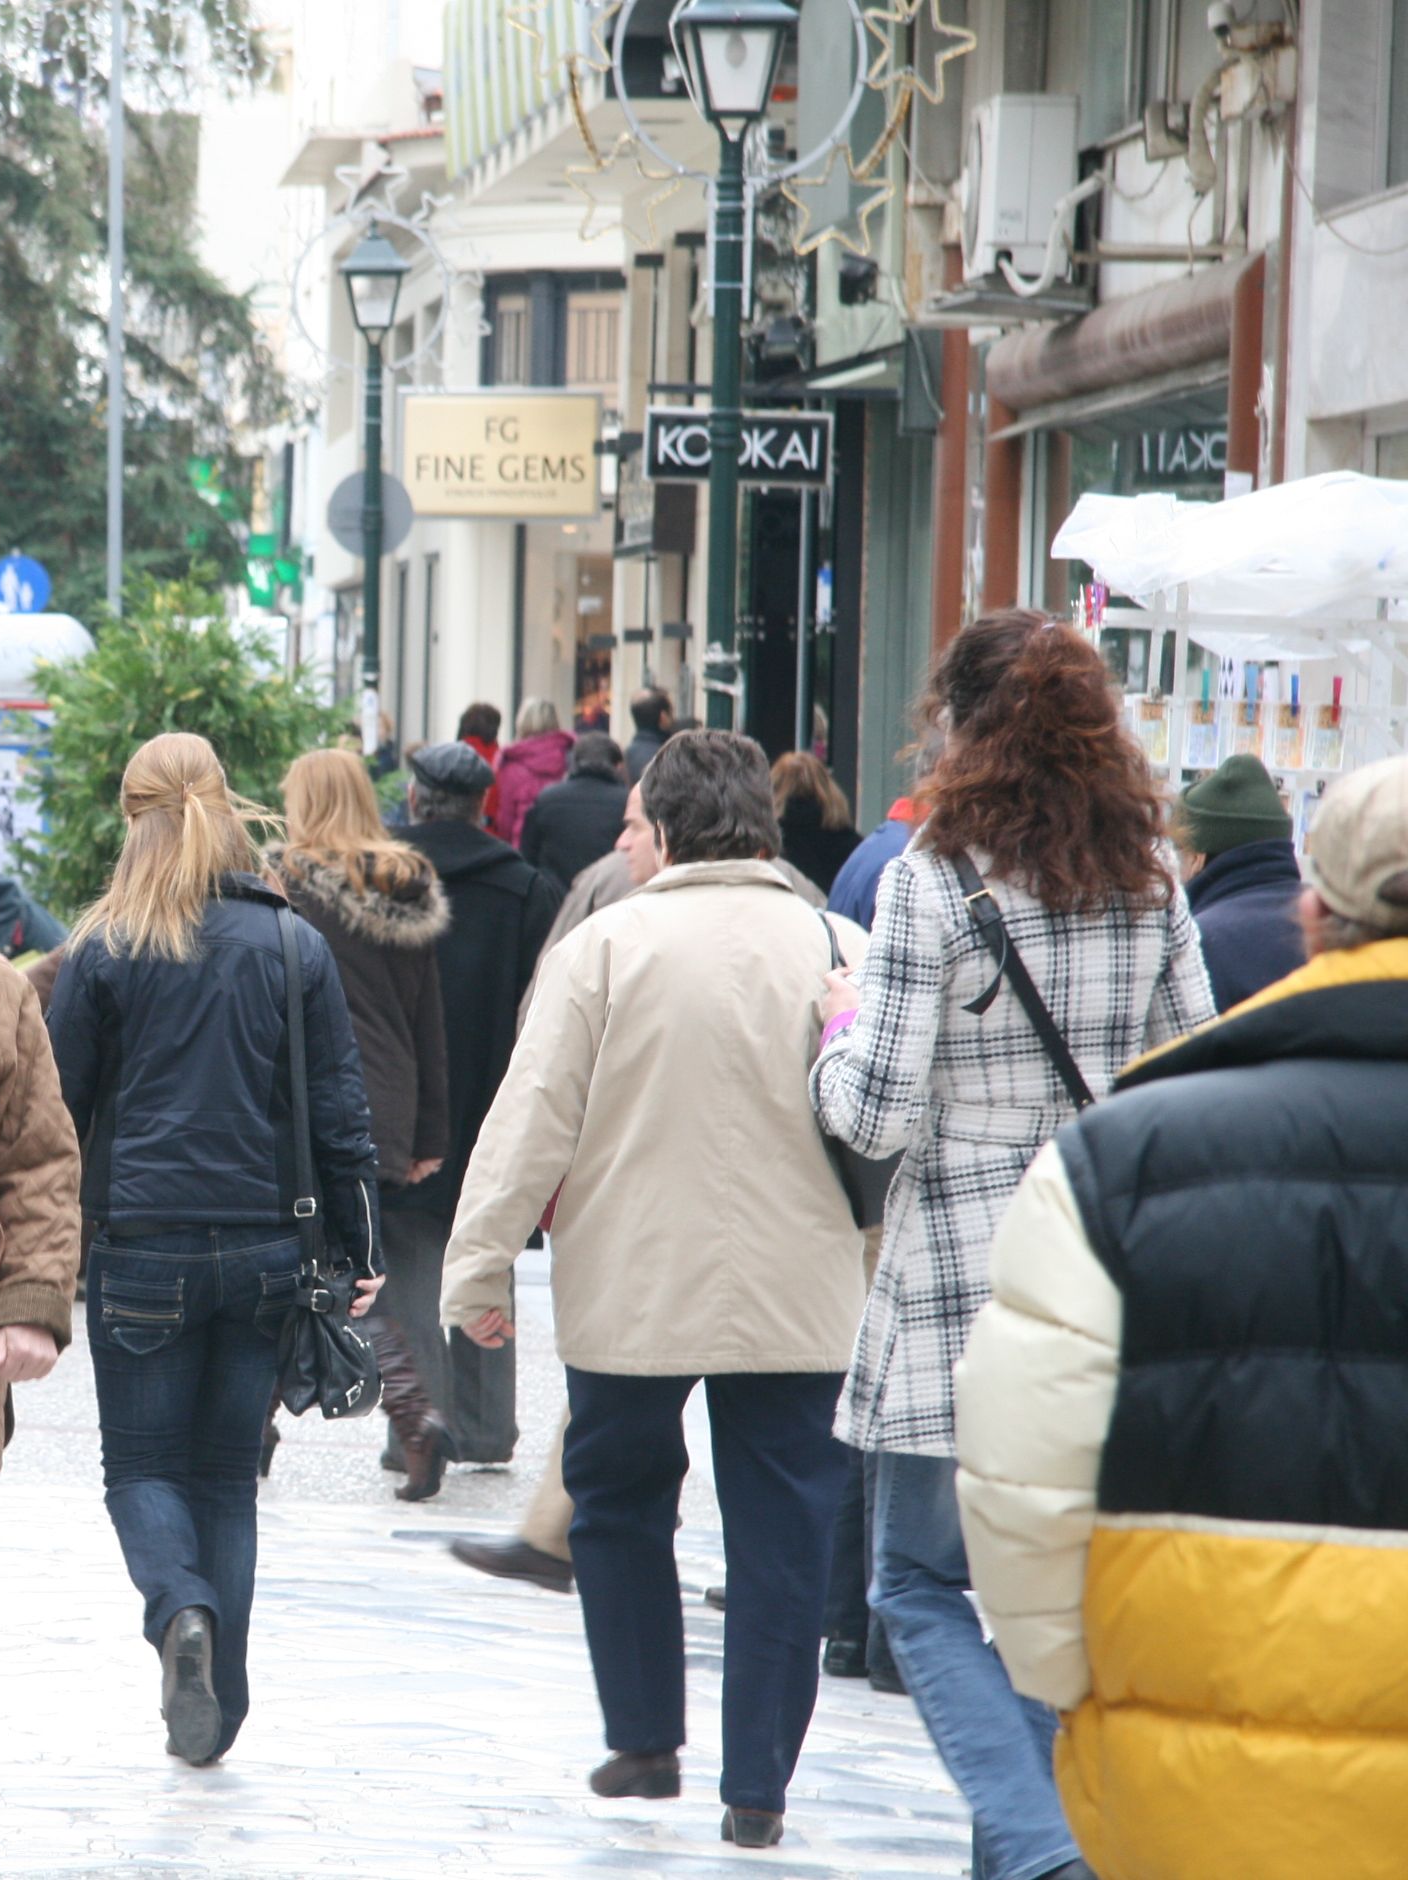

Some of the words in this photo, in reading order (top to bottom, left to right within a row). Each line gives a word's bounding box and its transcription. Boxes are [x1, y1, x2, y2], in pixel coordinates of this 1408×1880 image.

[484, 416, 520, 443] FG
[657, 425, 821, 471] KOKAI
[415, 454, 487, 482] FINE
[497, 454, 586, 484] GEMS
